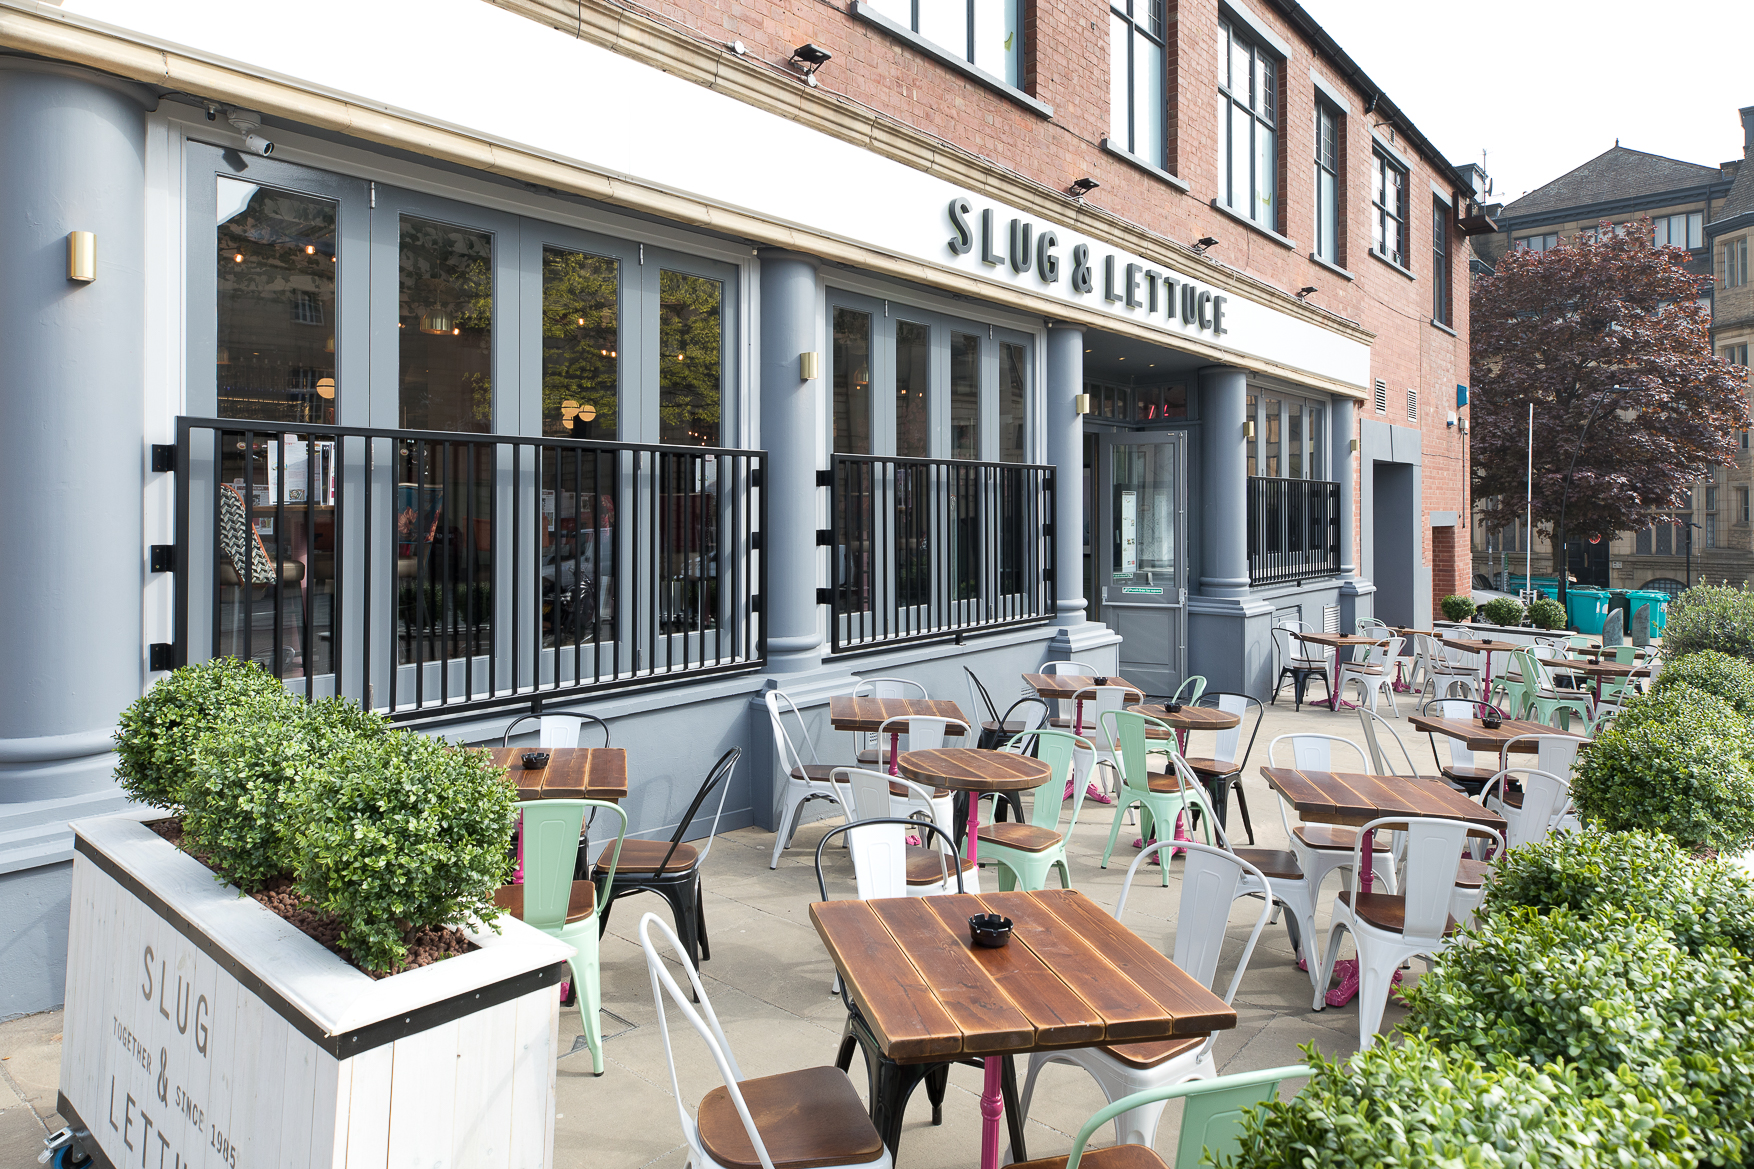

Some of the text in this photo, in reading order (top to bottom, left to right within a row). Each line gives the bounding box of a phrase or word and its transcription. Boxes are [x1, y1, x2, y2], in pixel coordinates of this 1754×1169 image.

[948, 196, 1228, 336] SLUG & LETTUCE
[141, 945, 209, 1059] SLUG
[109, 1074, 188, 1169] LETT
[113, 1016, 236, 1169] TOGETHER & SINCE 1985
